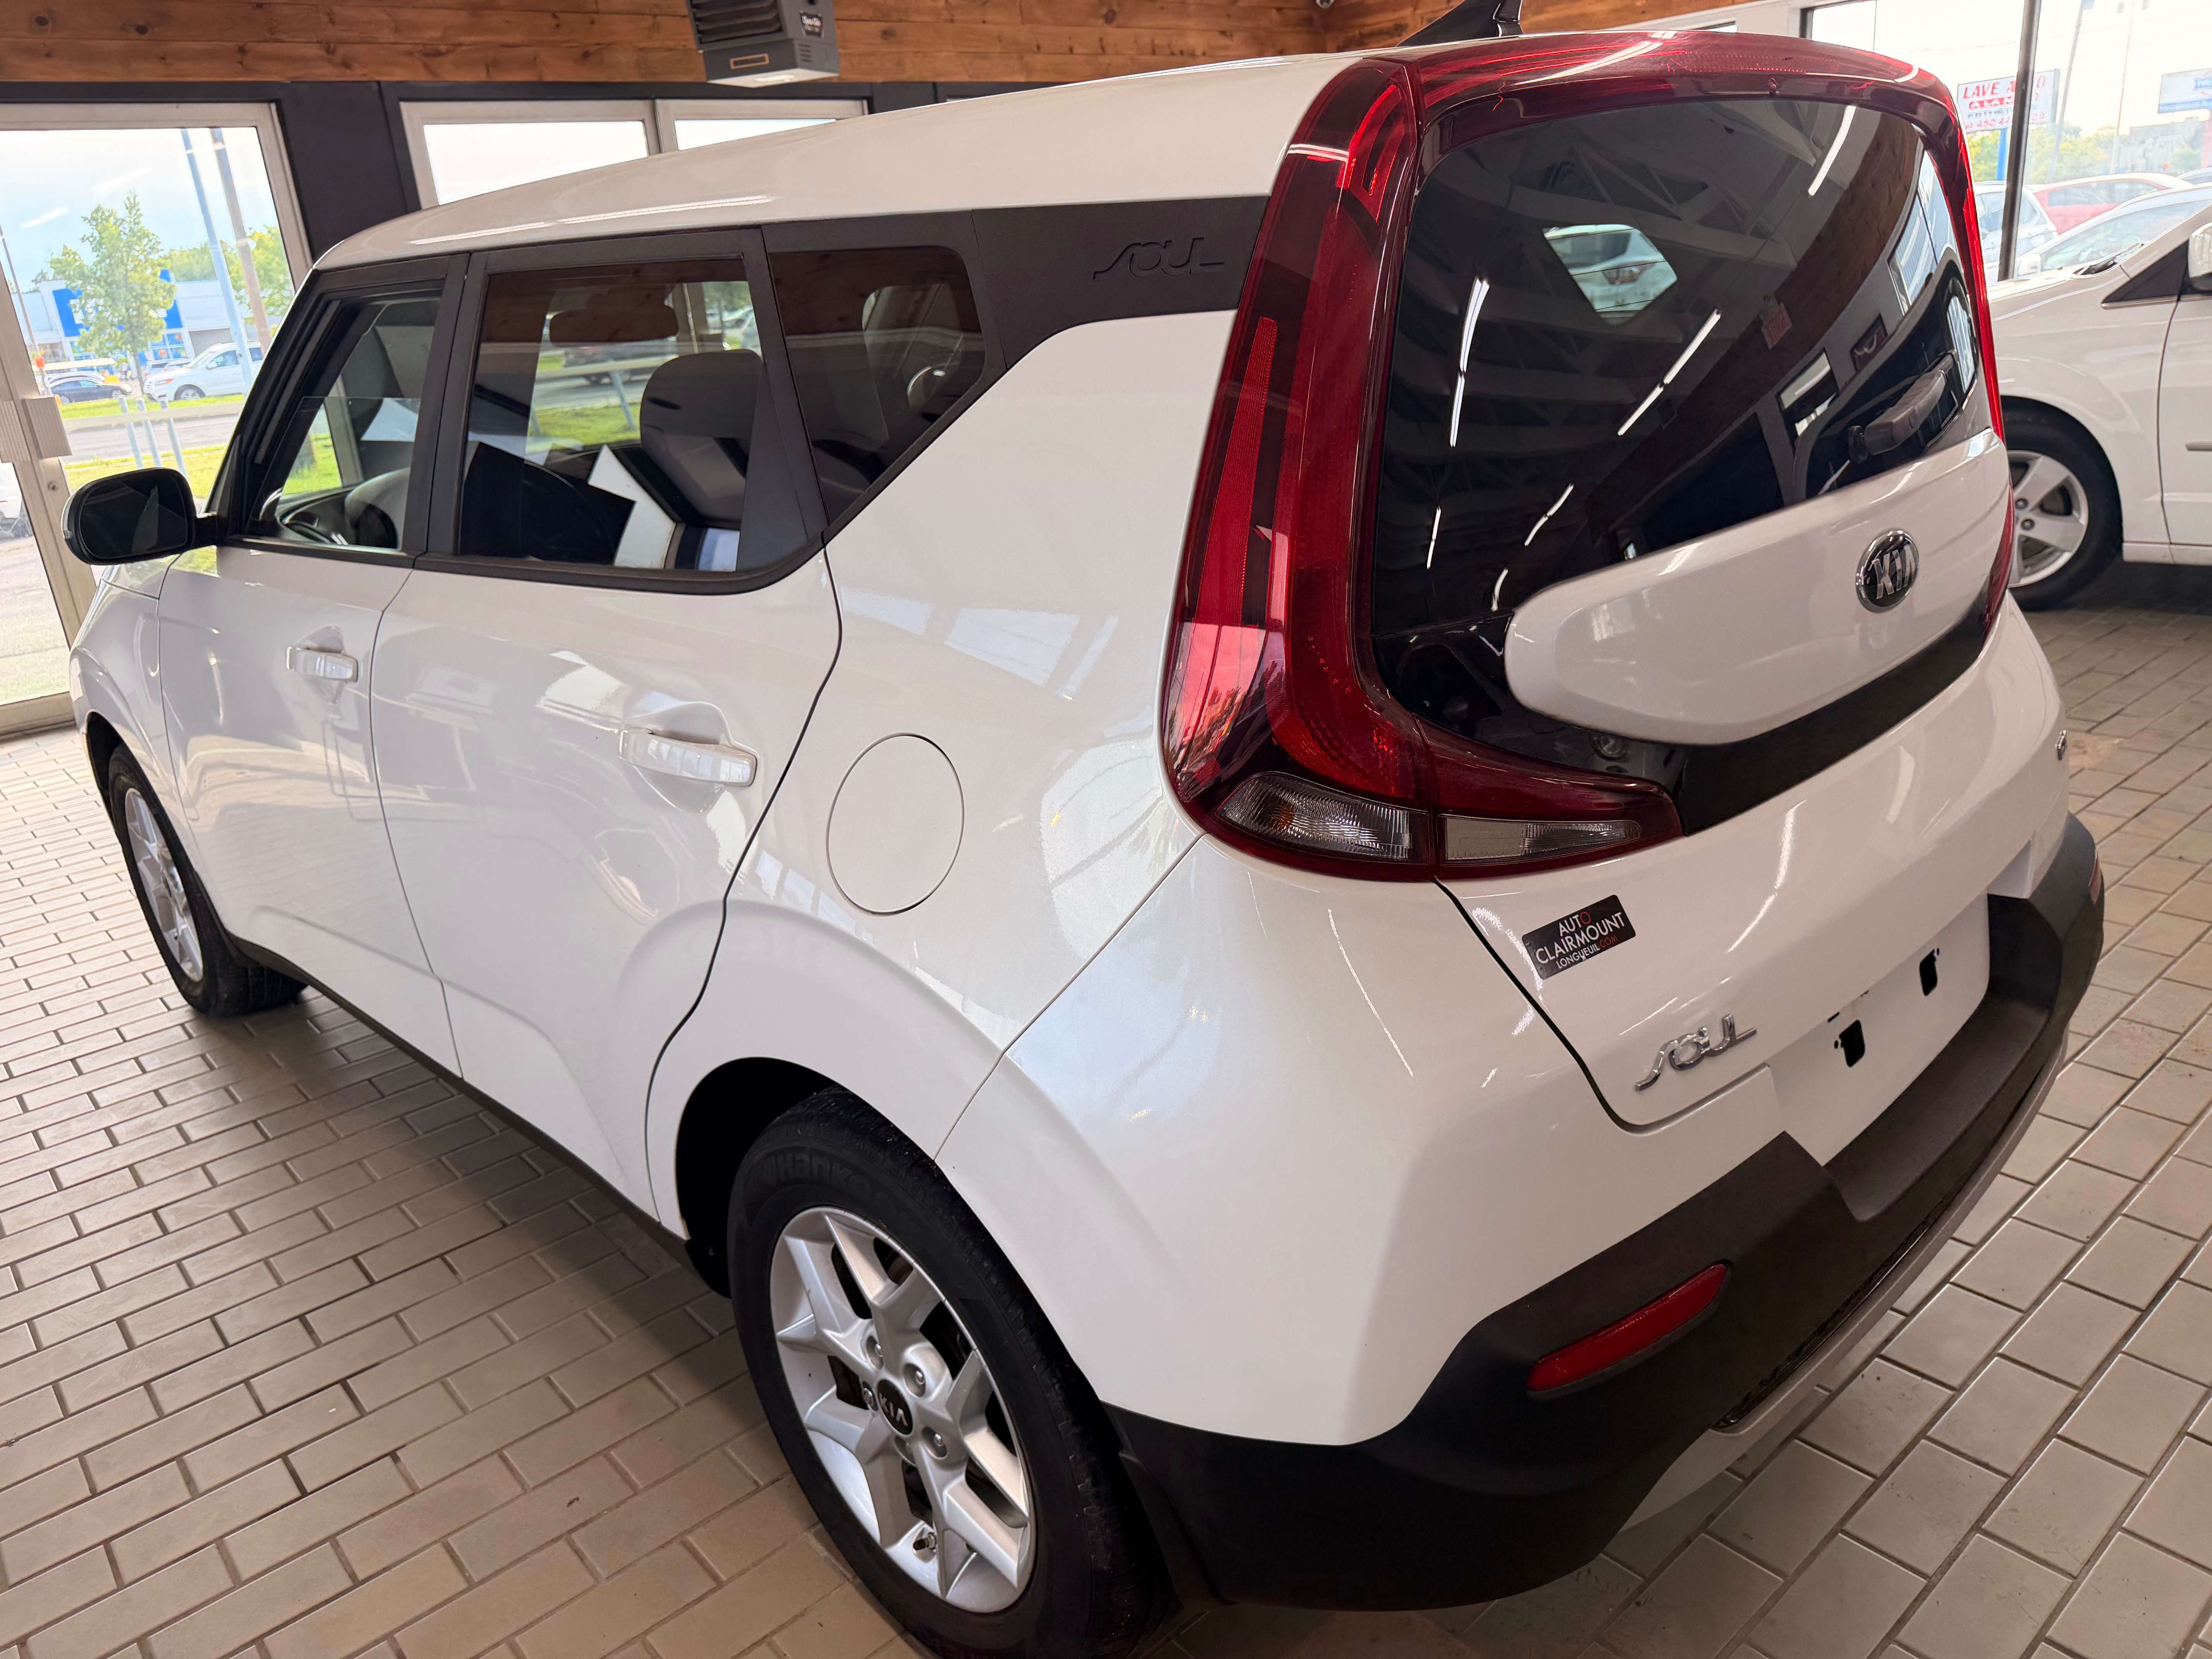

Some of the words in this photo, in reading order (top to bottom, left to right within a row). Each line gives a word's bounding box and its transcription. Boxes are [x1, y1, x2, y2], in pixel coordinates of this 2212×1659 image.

[1963, 82, 2000, 99] LAVE
[1093, 237, 1225, 280] SOUL
[1873, 543, 1917, 600] KIA
[1535, 912, 1625, 964] CLAIRMOUNT
[1559, 911, 1592, 937] AUTO
[1556, 943, 1600, 969] LONGUEUIL
[1635, 1013, 1757, 1092] SOUL
[878, 1392, 908, 1427] KIA
